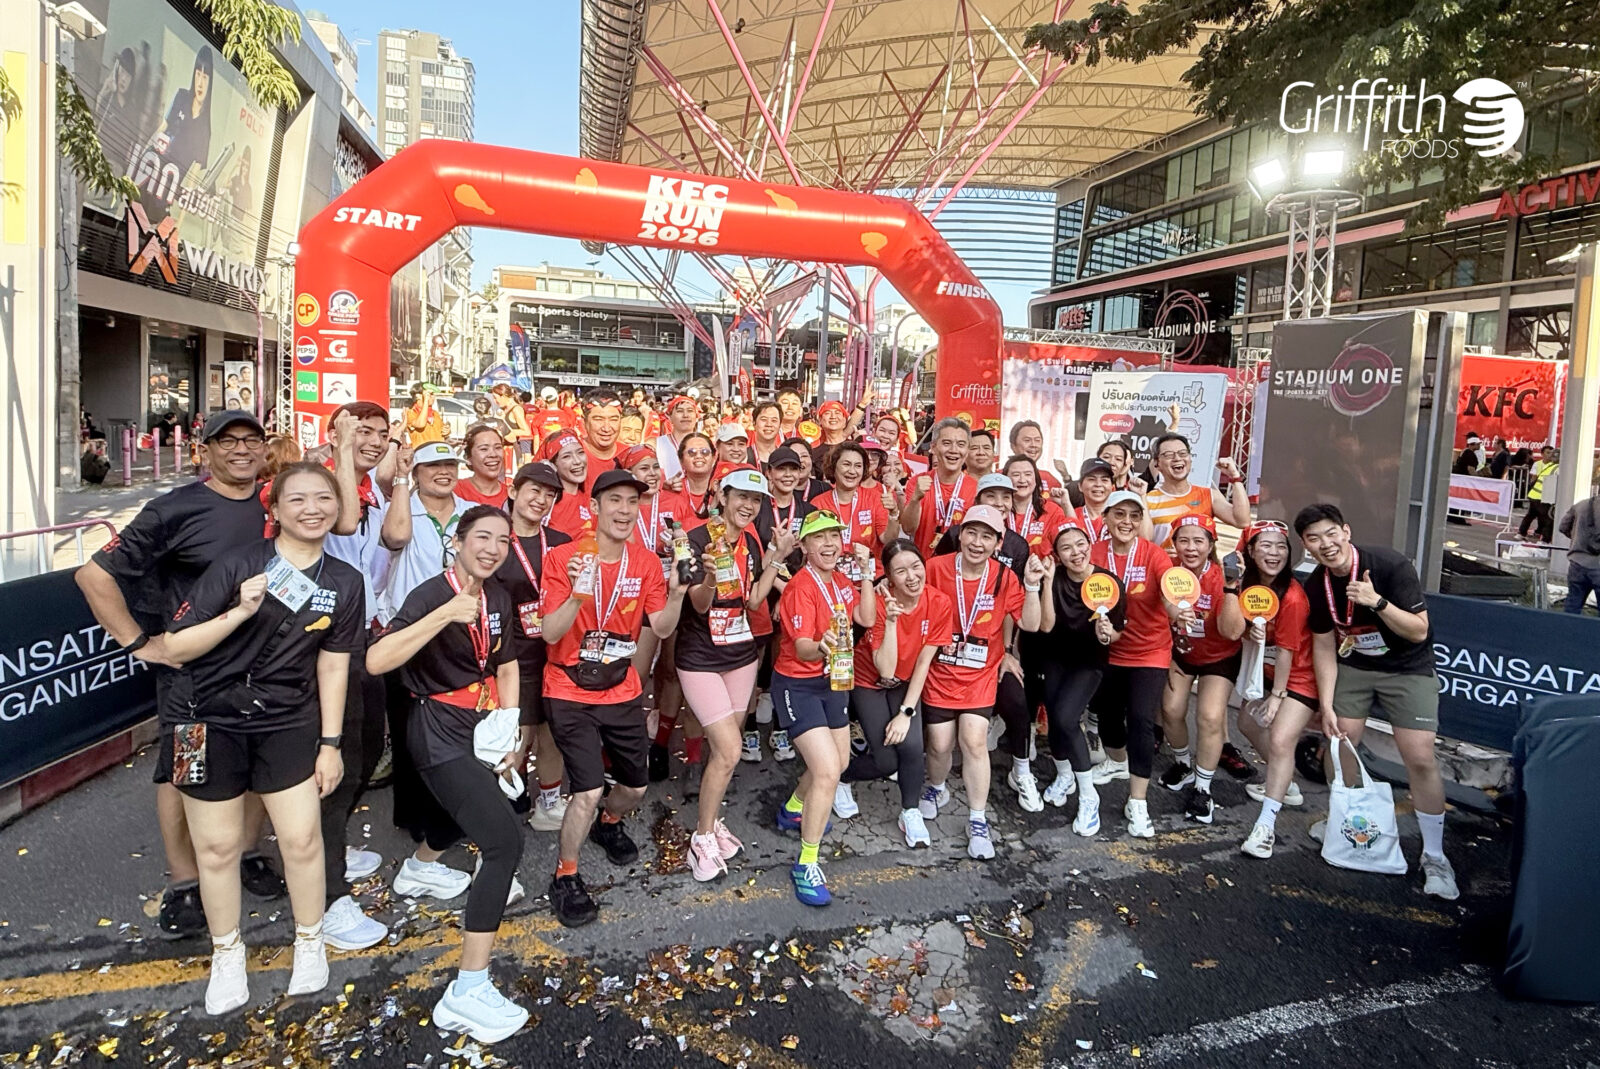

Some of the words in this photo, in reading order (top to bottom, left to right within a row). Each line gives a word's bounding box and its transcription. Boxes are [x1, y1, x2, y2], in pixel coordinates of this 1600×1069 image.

[646, 174, 729, 208] KFC
[333, 206, 422, 231] START
[640, 199, 724, 231] RUN
[637, 222, 720, 246] 2026
[182, 239, 271, 297] WARRIX
[936, 281, 992, 300] FINISH
[297, 303, 315, 317] CP
[516, 303, 537, 315] The
[538, 306, 571, 317] Sports
[572, 309, 609, 322] Society
[1148, 323, 1191, 339] STADIUM
[1194, 320, 1216, 334] ONE
[328, 338, 348, 358] G
[1274, 368, 1354, 385] STADIUM
[1361, 367, 1403, 384] ONE
[297, 381, 318, 392] Grab
[951, 383, 993, 404] Griffith
[1463, 385, 1539, 419] KFC
[582, 554, 594, 564] G
[620, 577, 642, 586] KFC
[311, 596, 336, 607] RUN
[313, 588, 337, 599] KFC
[309, 604, 335, 614] 2026
[489, 612, 501, 621] KF
[710, 610, 729, 618] KFC
[490, 620, 501, 629] RU
[938, 653, 957, 662] RUN
